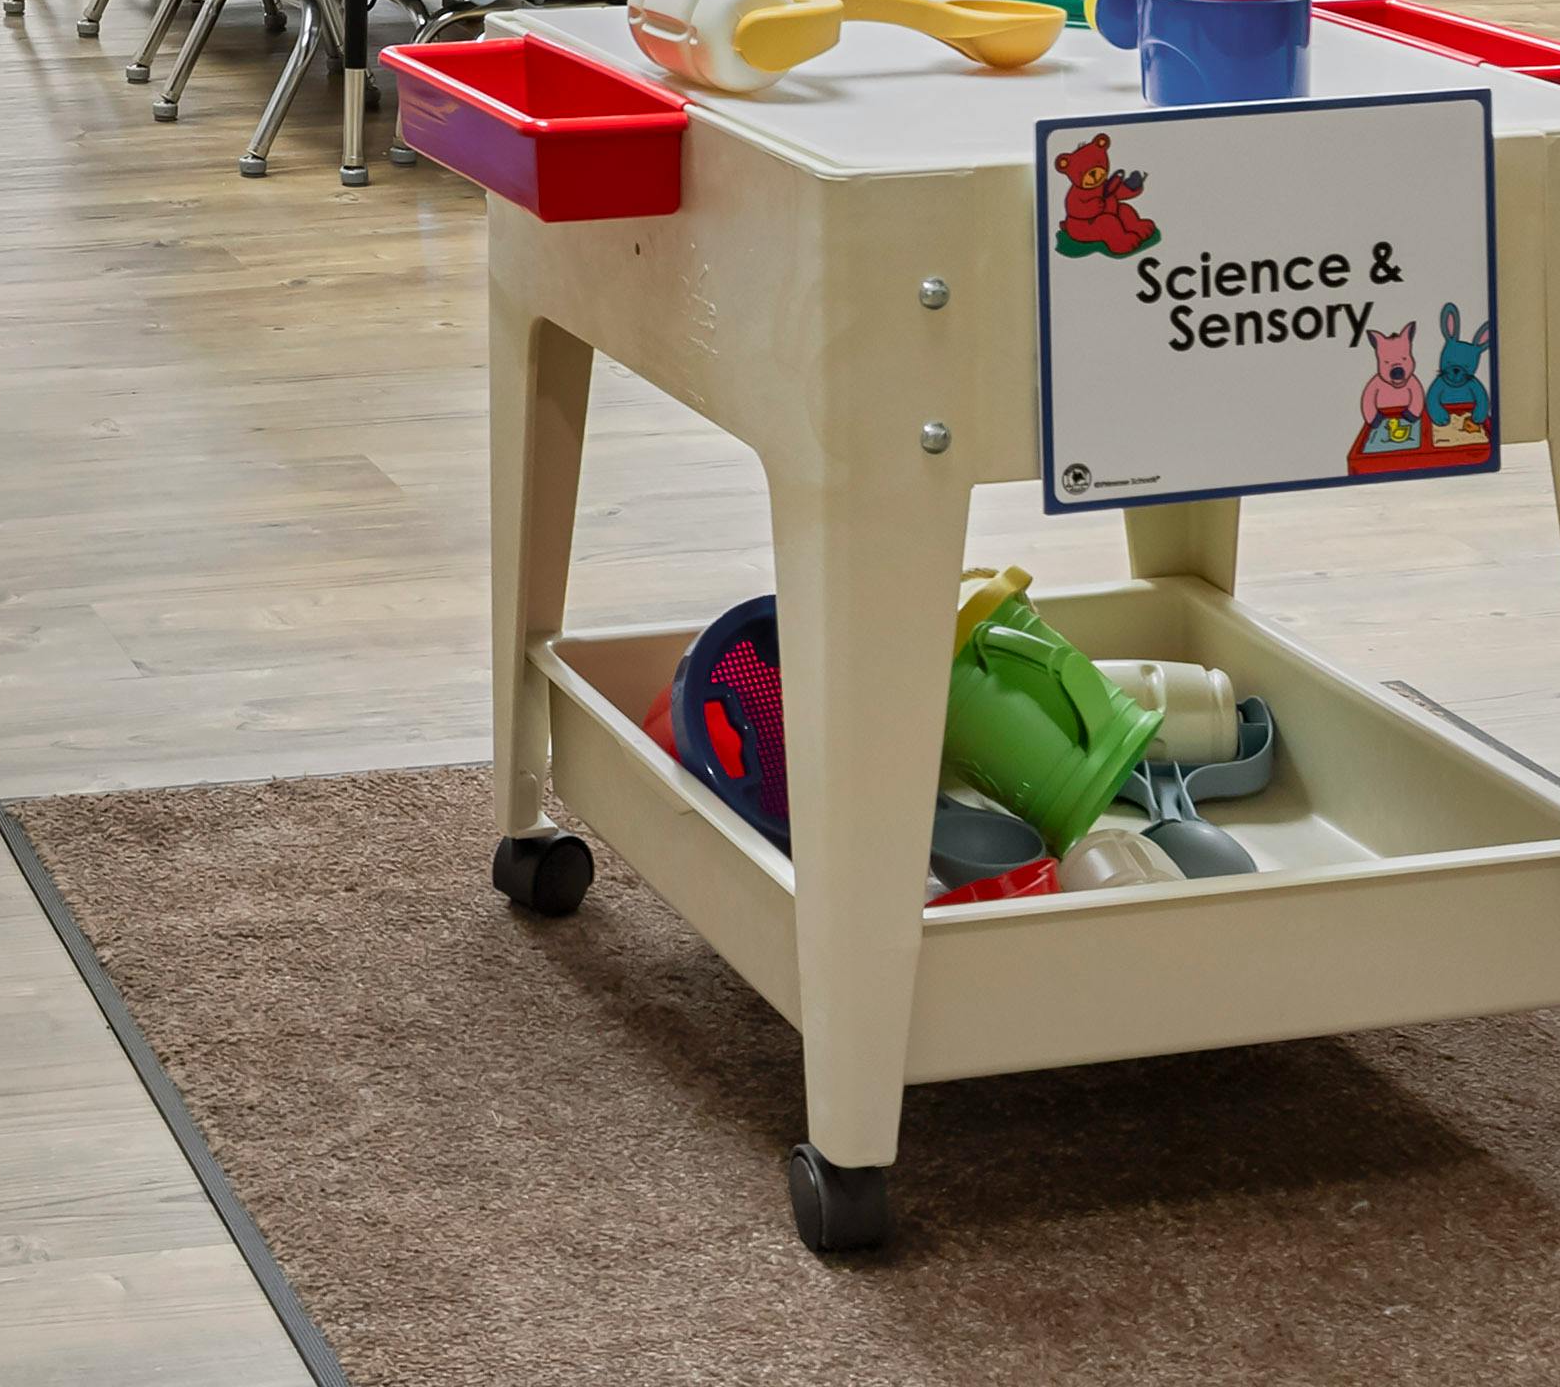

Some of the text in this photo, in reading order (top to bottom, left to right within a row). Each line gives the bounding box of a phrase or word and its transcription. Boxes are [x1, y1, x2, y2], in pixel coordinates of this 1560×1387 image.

[1136, 241, 1404, 304] Science &
[1168, 301, 1374, 352] Sensory
